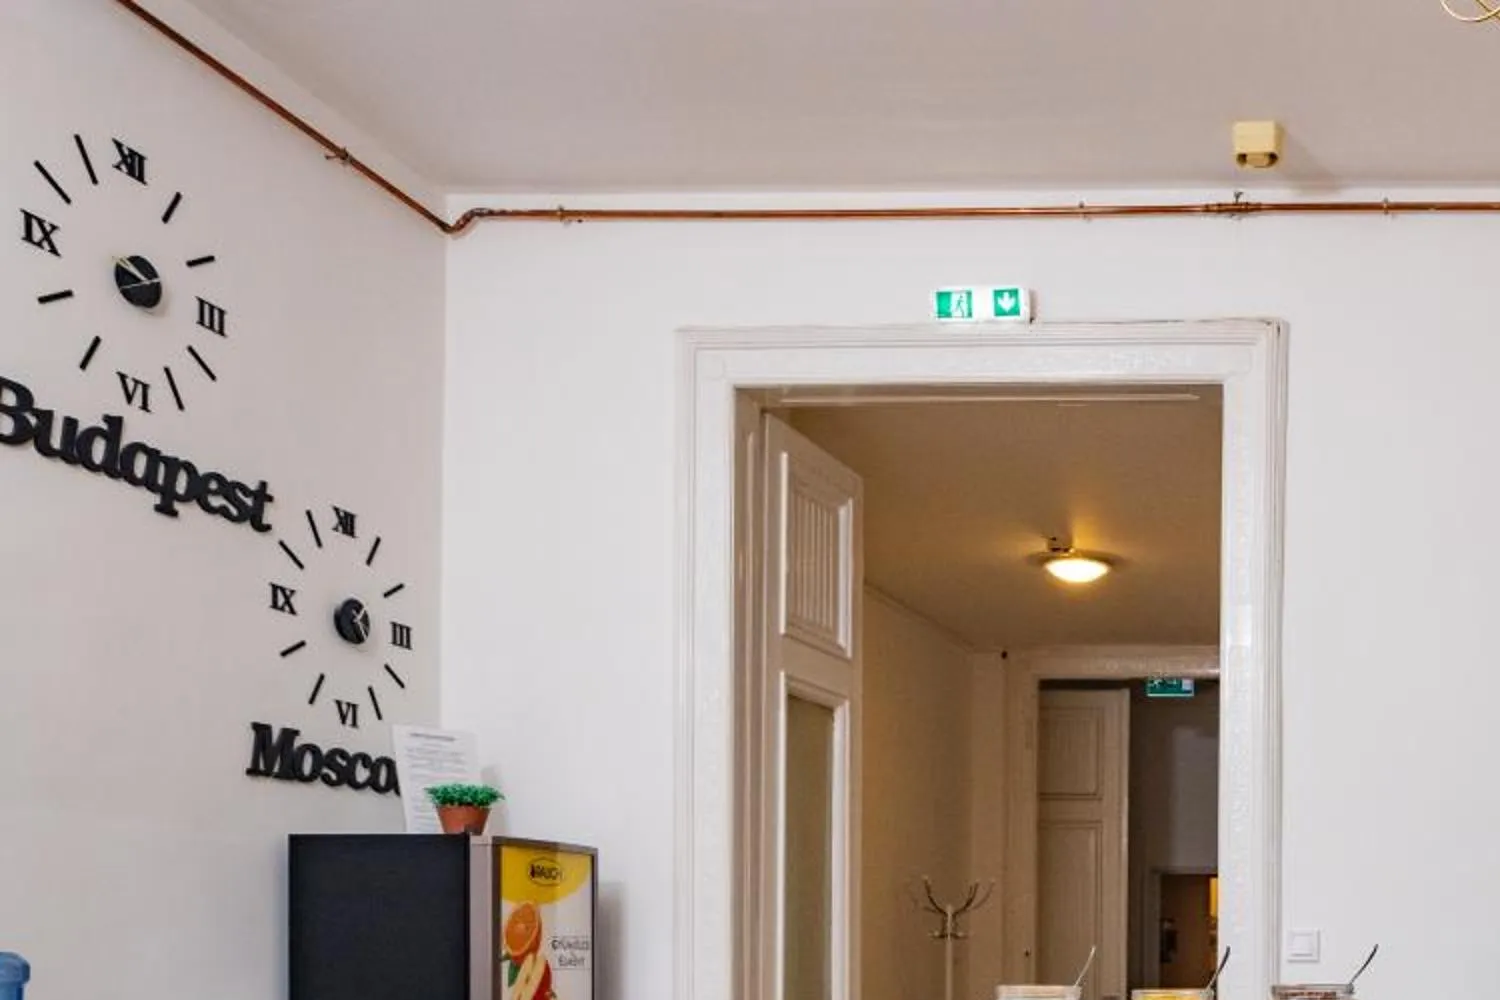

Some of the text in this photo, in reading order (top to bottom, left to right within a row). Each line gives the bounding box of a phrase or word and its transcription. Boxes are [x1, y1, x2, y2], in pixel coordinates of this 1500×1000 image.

[112, 138, 148, 185] XII
[20, 208, 62, 257] IX
[195, 296, 227, 337] III
[117, 371, 152, 413] VI
[0, 376, 275, 533] Budapest
[332, 506, 357, 538] XII
[268, 582, 297, 616] IX
[390, 622, 412, 650] III
[335, 699, 359, 728] VI
[246, 721, 401, 797] Mosco
